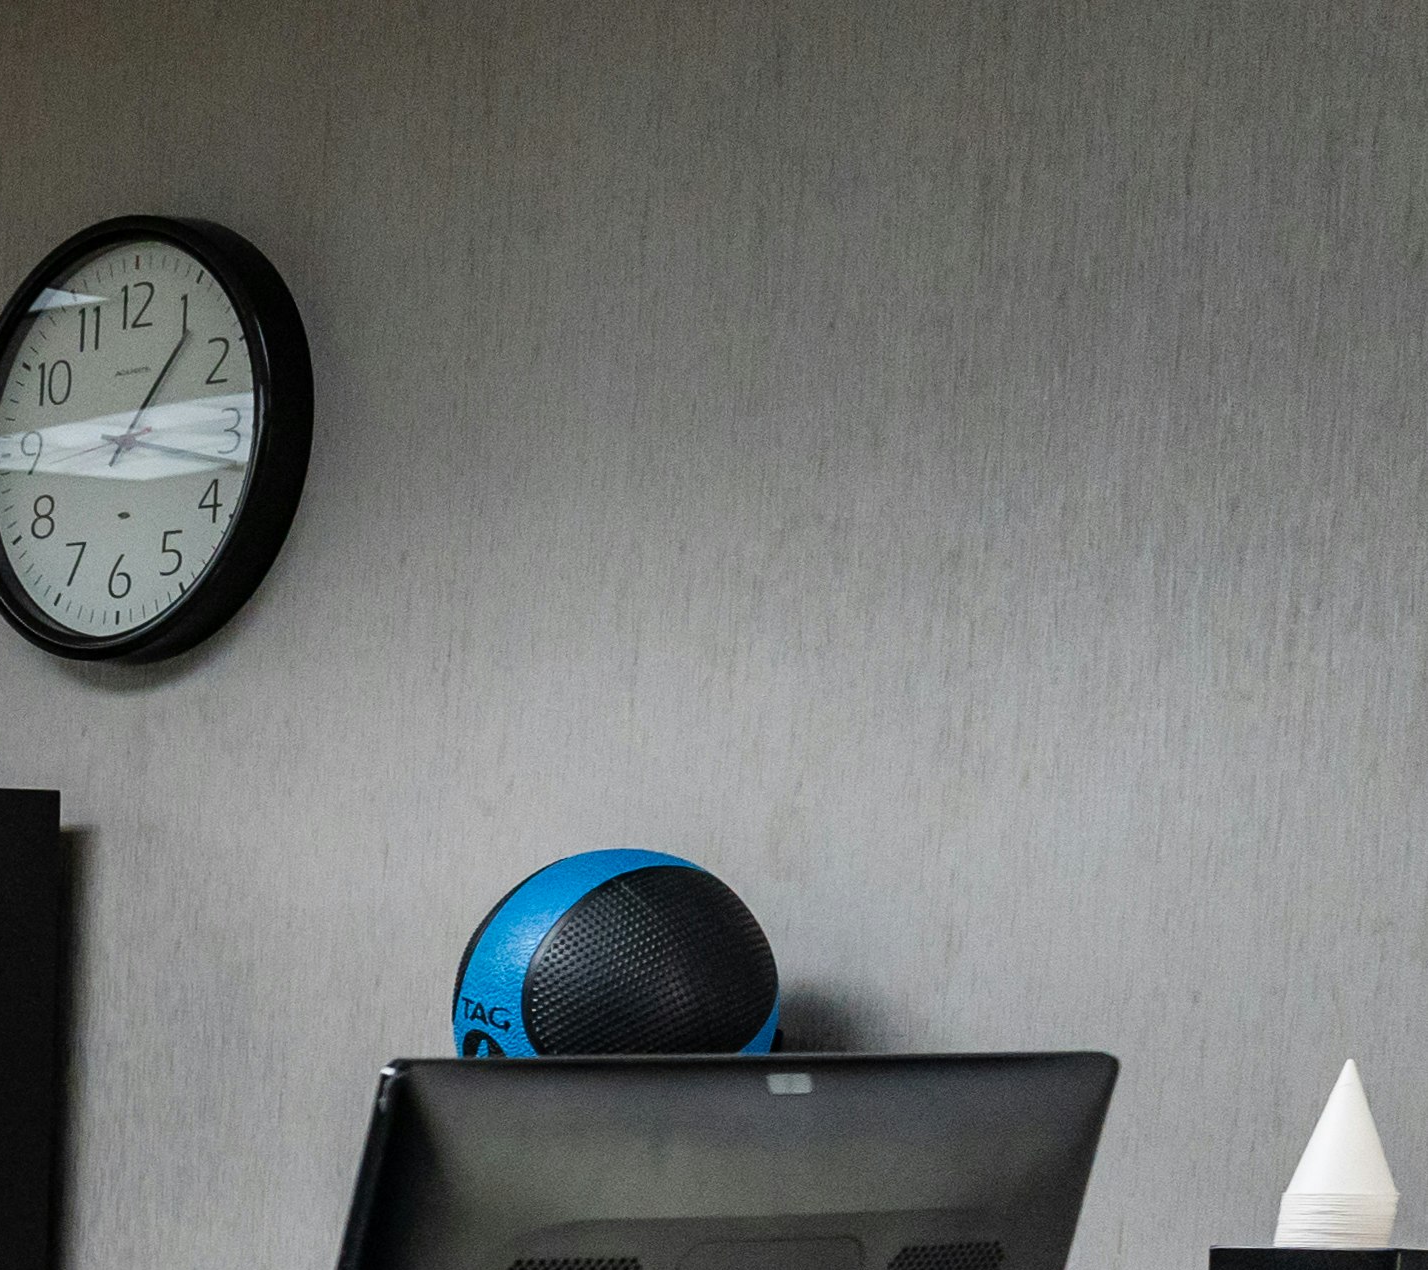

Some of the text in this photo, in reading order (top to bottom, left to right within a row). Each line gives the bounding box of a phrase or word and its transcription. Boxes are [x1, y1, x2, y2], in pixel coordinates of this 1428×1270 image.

[121, 282, 155, 330] 12
[180, 294, 189, 334] 1
[78, 306, 101, 351] 11
[38, 359, 72, 406] 10
[205, 337, 230, 384] 2
[218, 408, 241, 453] 3
[20, 431, 43, 475] 9
[31, 495, 54, 538] 8
[198, 479, 222, 522] 4
[66, 542, 86, 586] 7
[160, 531, 183, 576] 5
[108, 554, 131, 598] 6
[461, 996, 512, 1032] TAG
